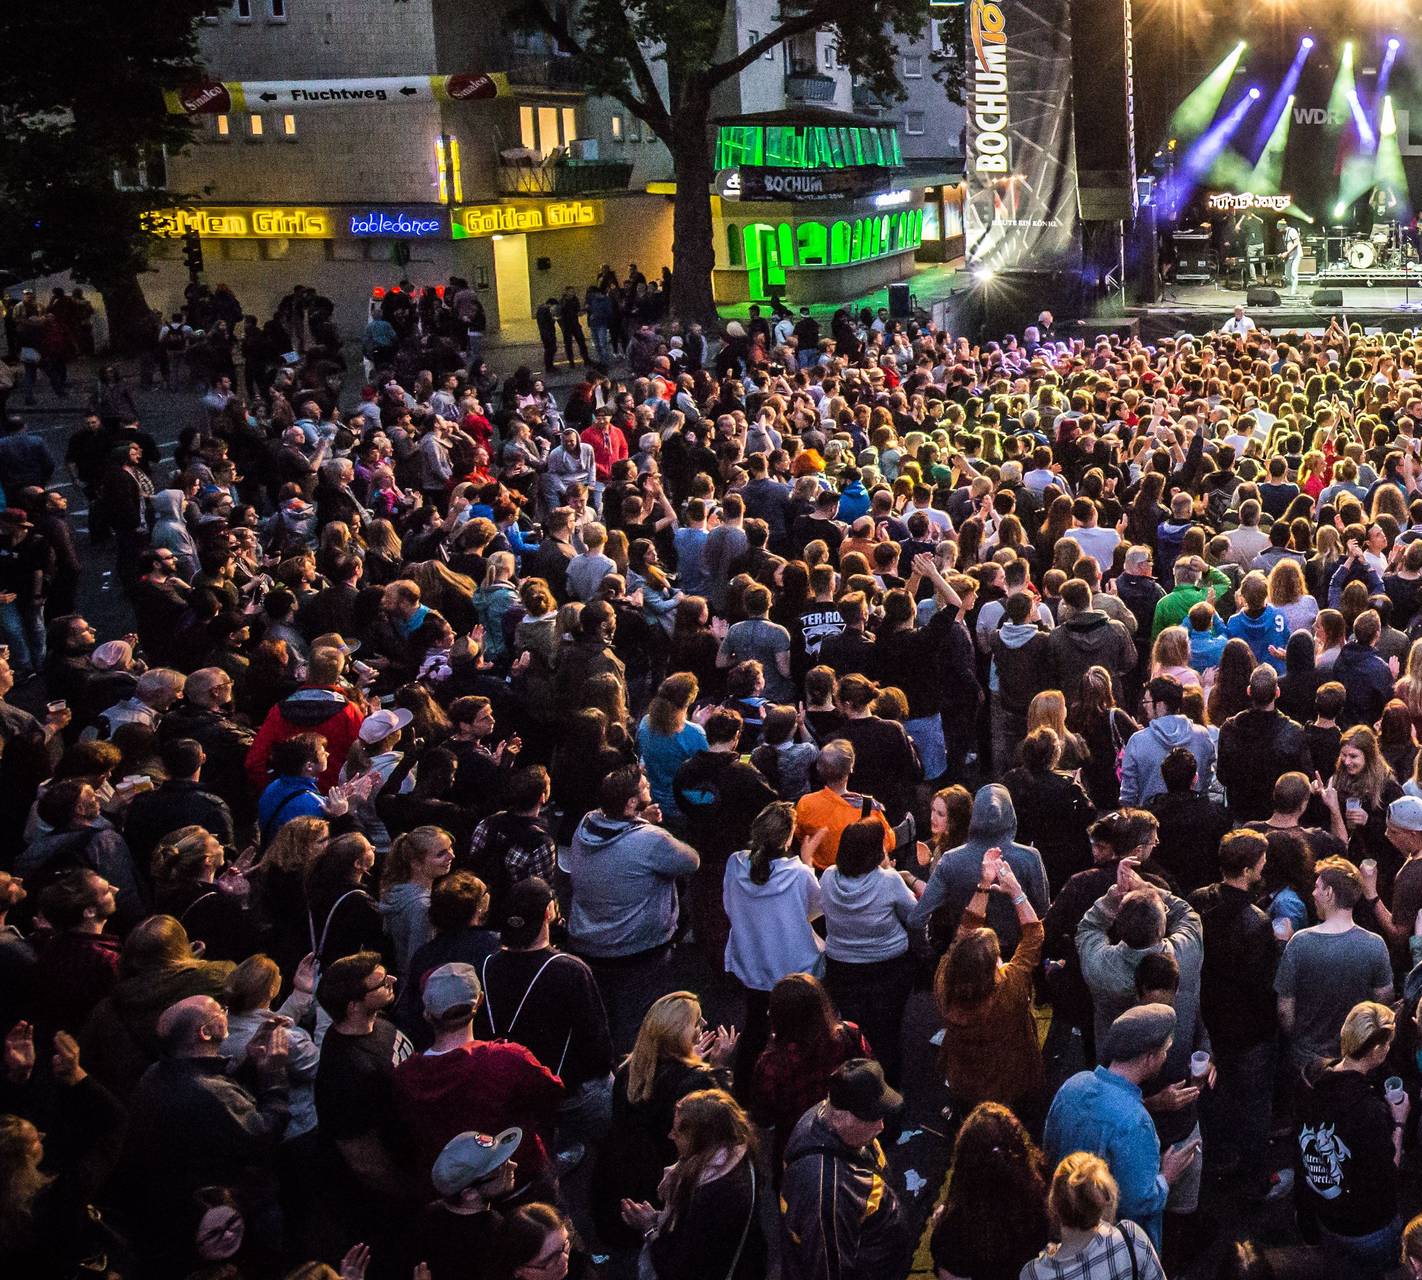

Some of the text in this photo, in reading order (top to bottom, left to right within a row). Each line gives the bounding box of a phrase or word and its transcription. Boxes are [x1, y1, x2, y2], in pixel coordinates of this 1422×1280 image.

[185, 86, 223, 111] Sinalco
[291, 88, 387, 101] Fluchtweg
[975, 45, 1007, 172] BOCHUM
[764, 174, 823, 193] BOCHUM
[1209, 192, 1291, 211] JUPITER JONES
[251, 209, 326, 234] Girls
[351, 213, 440, 236] tabledance
[466, 203, 593, 234] Golden Girls
[1275, 614, 1285, 633] 9
